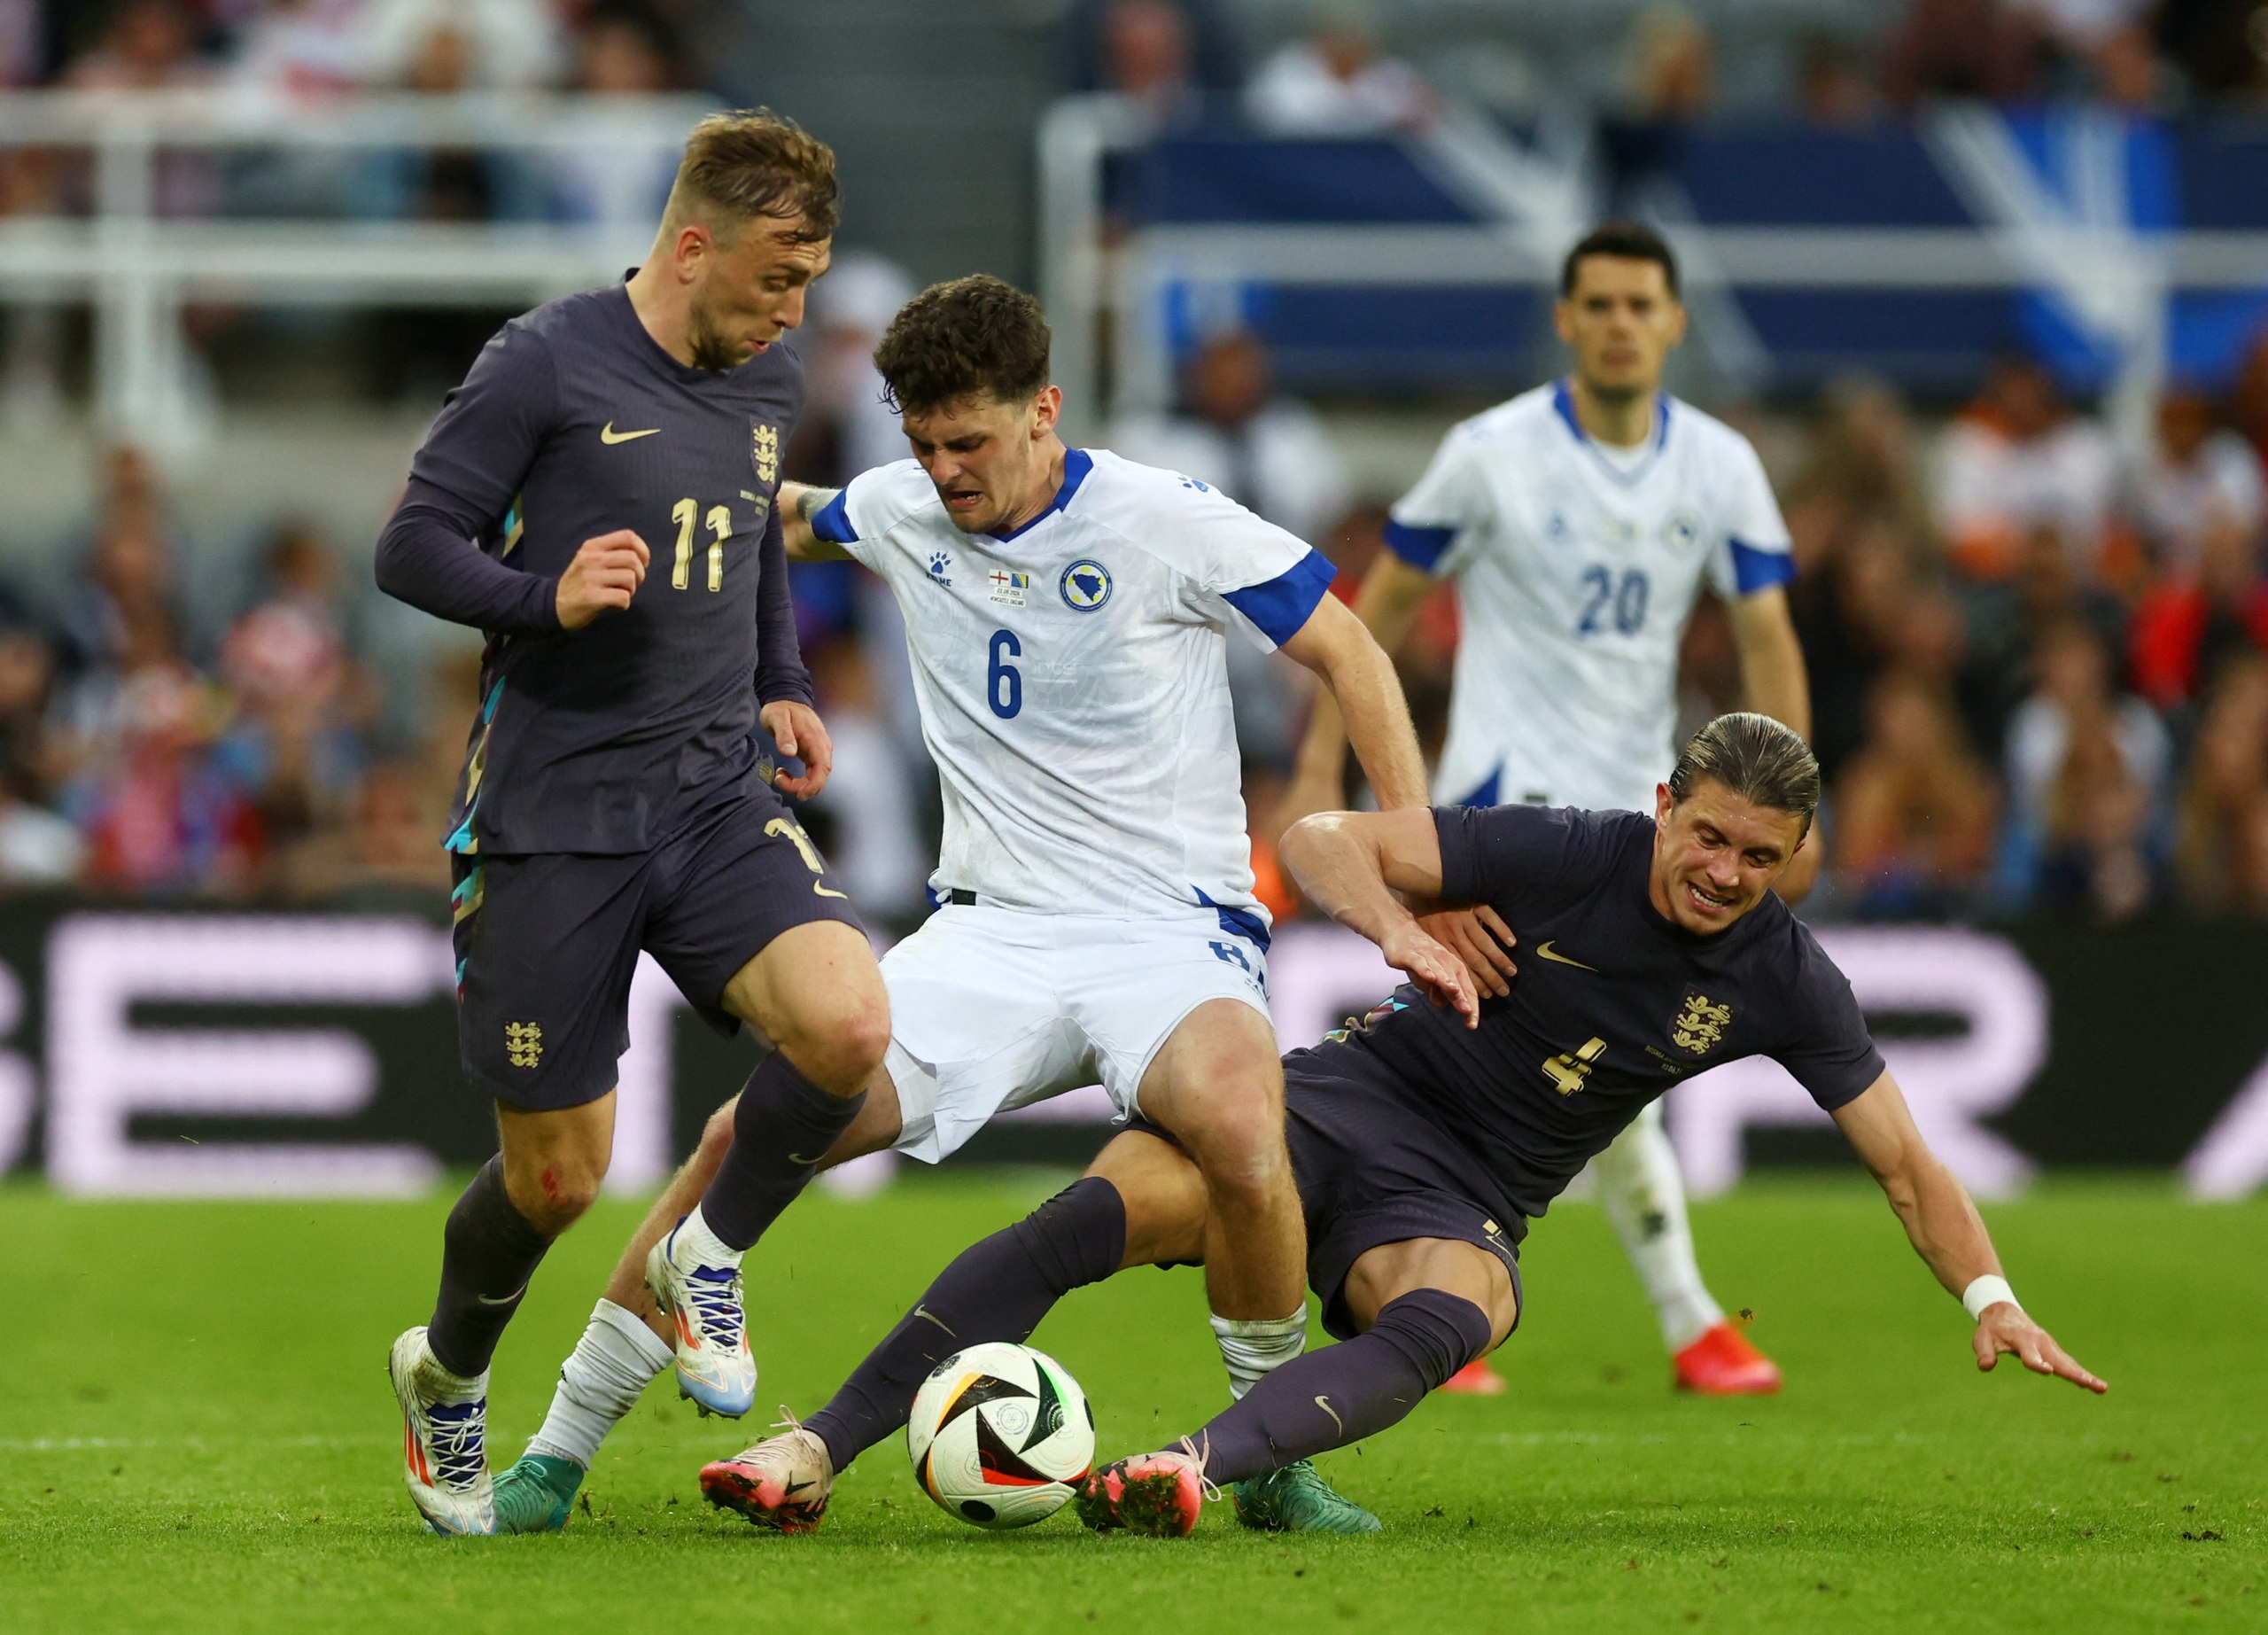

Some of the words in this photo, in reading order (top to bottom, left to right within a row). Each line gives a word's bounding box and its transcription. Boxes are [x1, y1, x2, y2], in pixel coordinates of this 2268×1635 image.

[672, 497, 733, 592] 11
[1580, 563, 1650, 636] 20
[988, 629, 1022, 720] 6
[1542, 1036, 1607, 1097] 4
